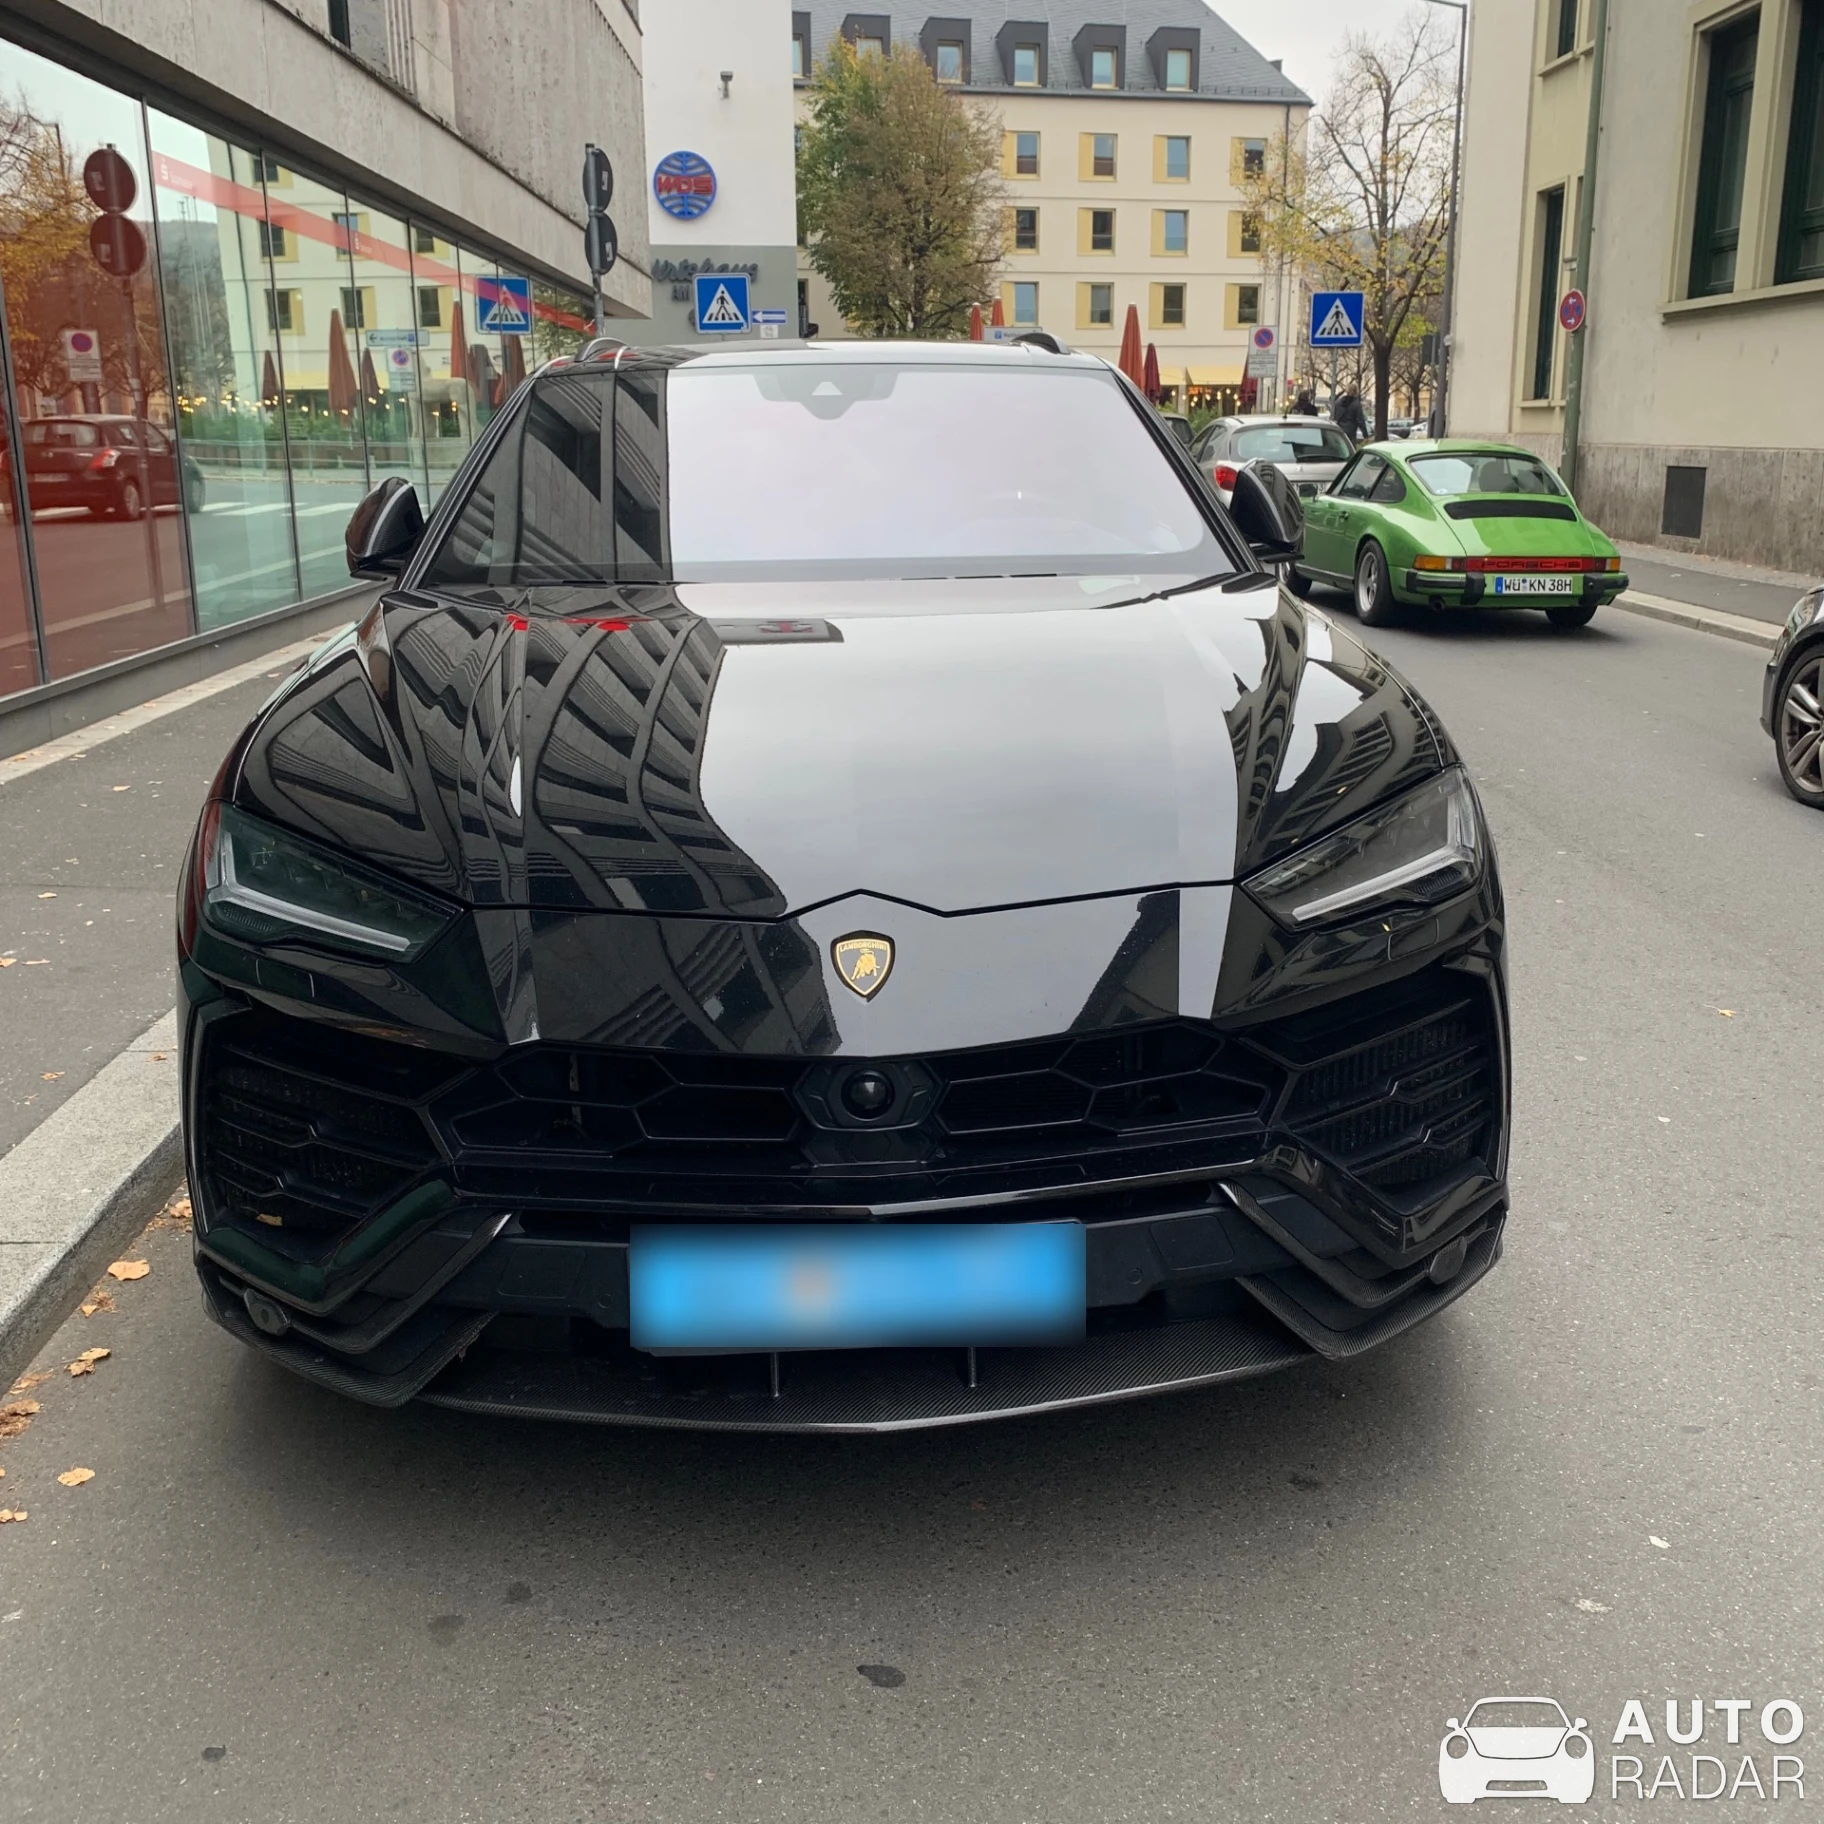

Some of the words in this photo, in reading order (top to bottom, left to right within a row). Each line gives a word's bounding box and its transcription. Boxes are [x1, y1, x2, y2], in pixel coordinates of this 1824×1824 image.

[1481, 560, 1581, 569] PORSCHE
[1529, 579, 1546, 592] KN
[1549, 579, 1572, 592] 38H
[840, 941, 887, 952] LAMBORGHINI
